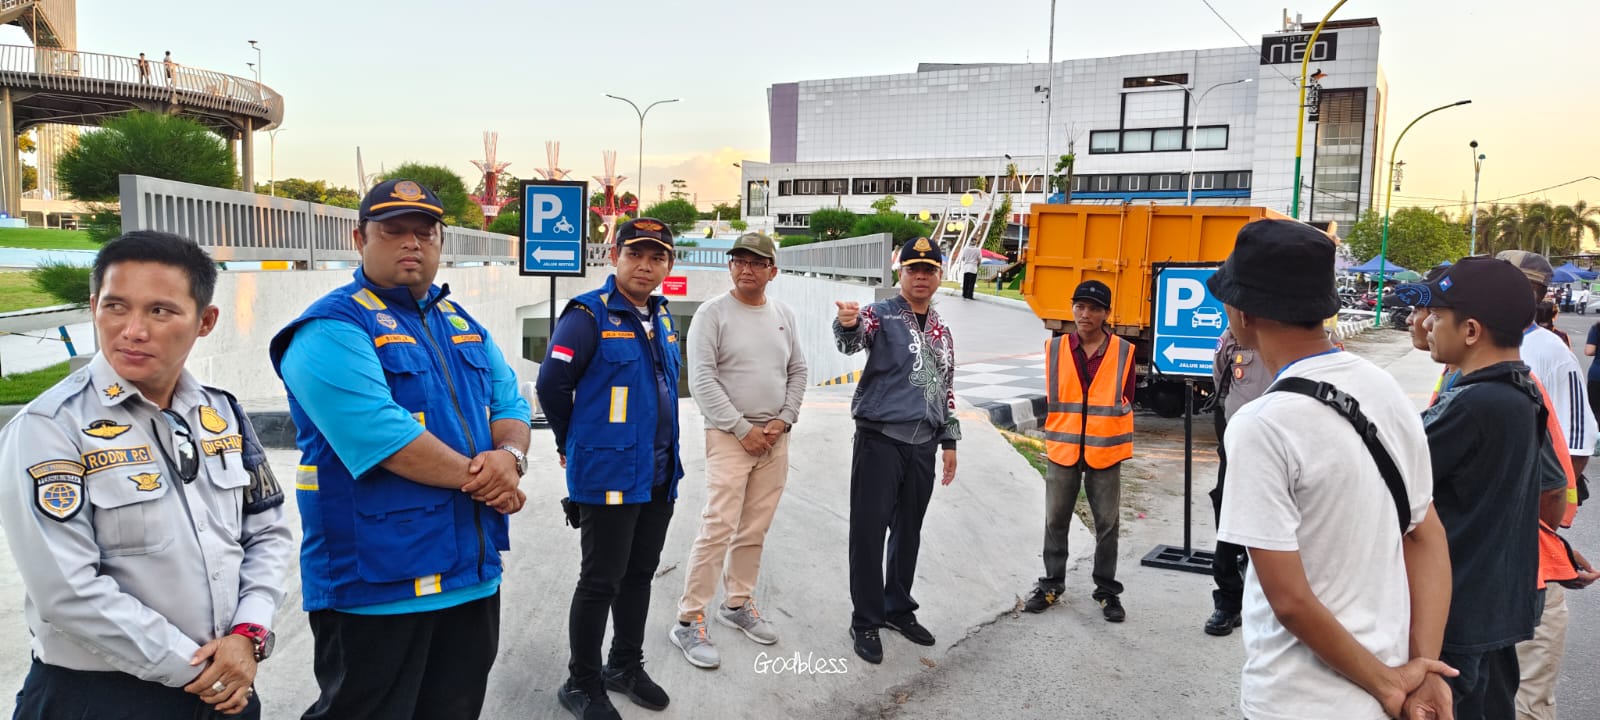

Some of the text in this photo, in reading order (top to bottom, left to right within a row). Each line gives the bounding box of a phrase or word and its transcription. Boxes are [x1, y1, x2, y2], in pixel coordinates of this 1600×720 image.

[533, 193, 563, 233] P
[1164, 278, 1206, 327] P
[88, 450, 128, 469] RODDY
[204, 435, 242, 453] DISHU
[243, 461, 281, 504] PA
